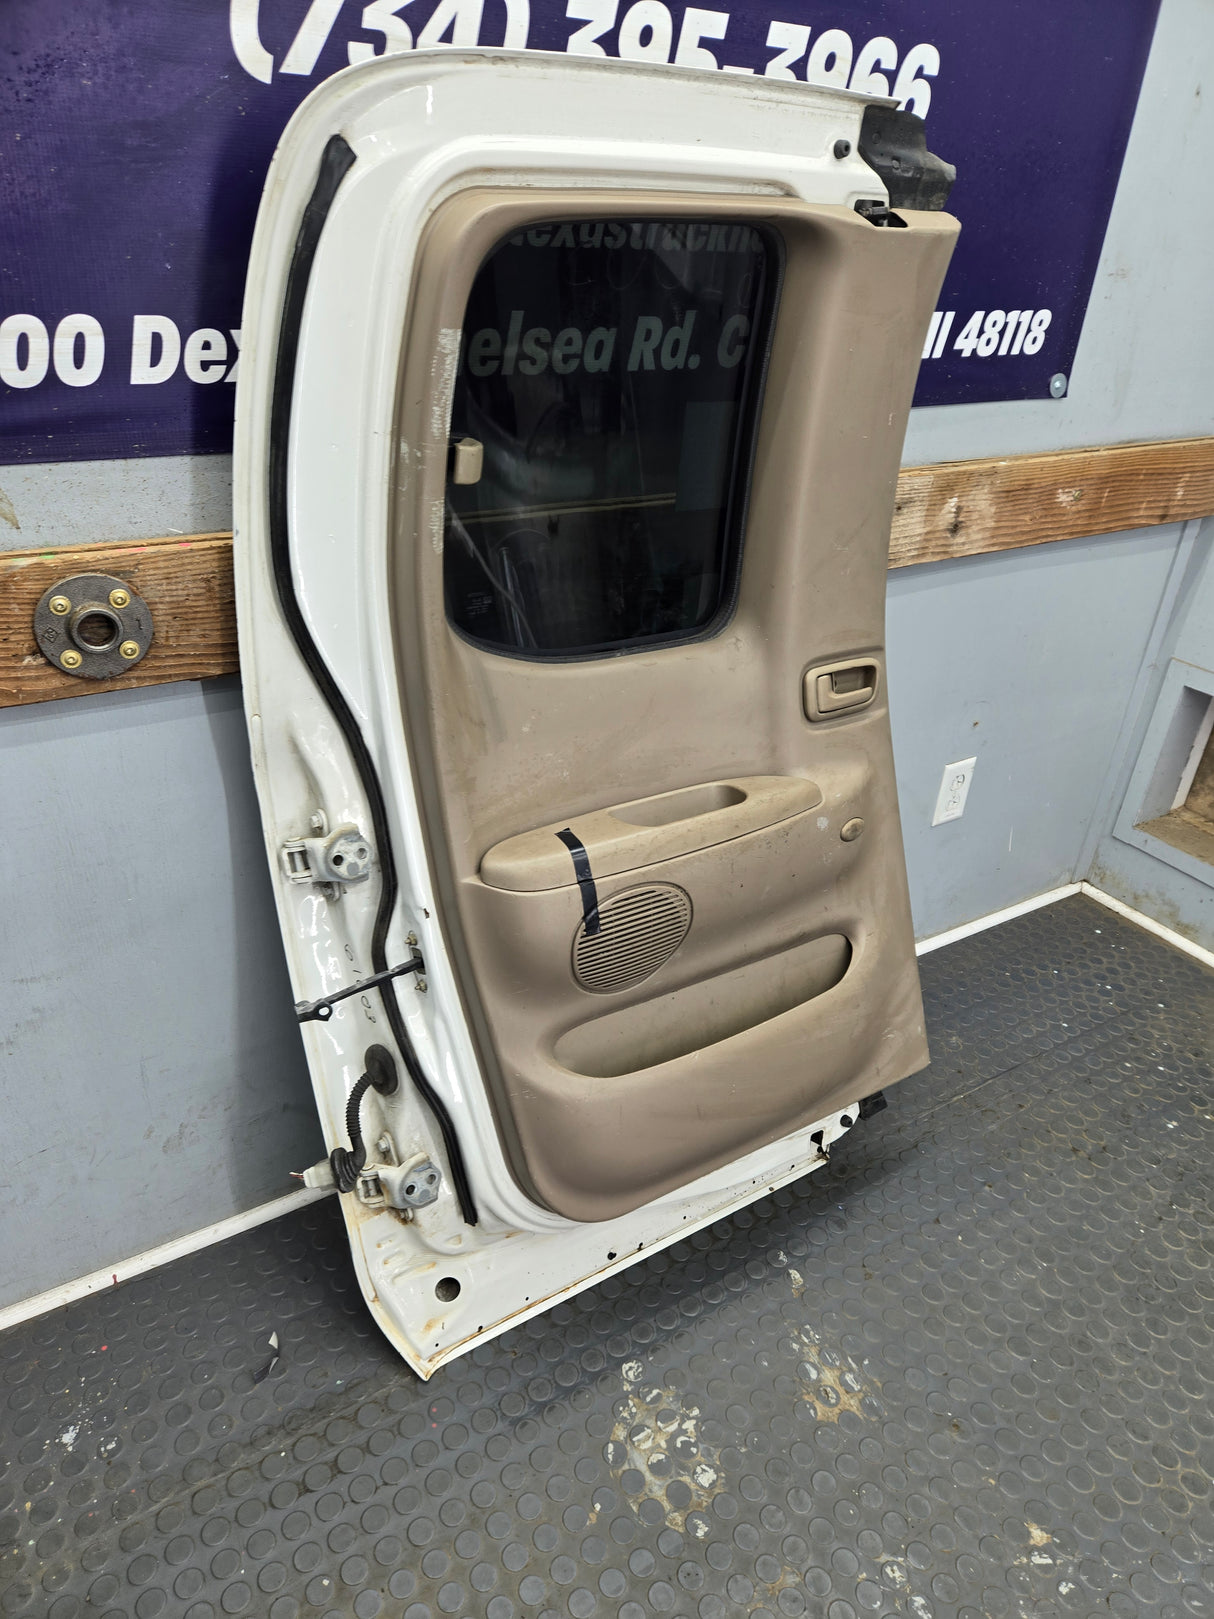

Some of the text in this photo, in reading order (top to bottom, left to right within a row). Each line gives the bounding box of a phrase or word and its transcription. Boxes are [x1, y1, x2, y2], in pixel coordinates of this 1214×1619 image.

[0, 313, 105, 389] 00
[459, 310, 617, 377] elsea
[627, 310, 700, 372] Rd.
[953, 309, 1052, 357] 48118
